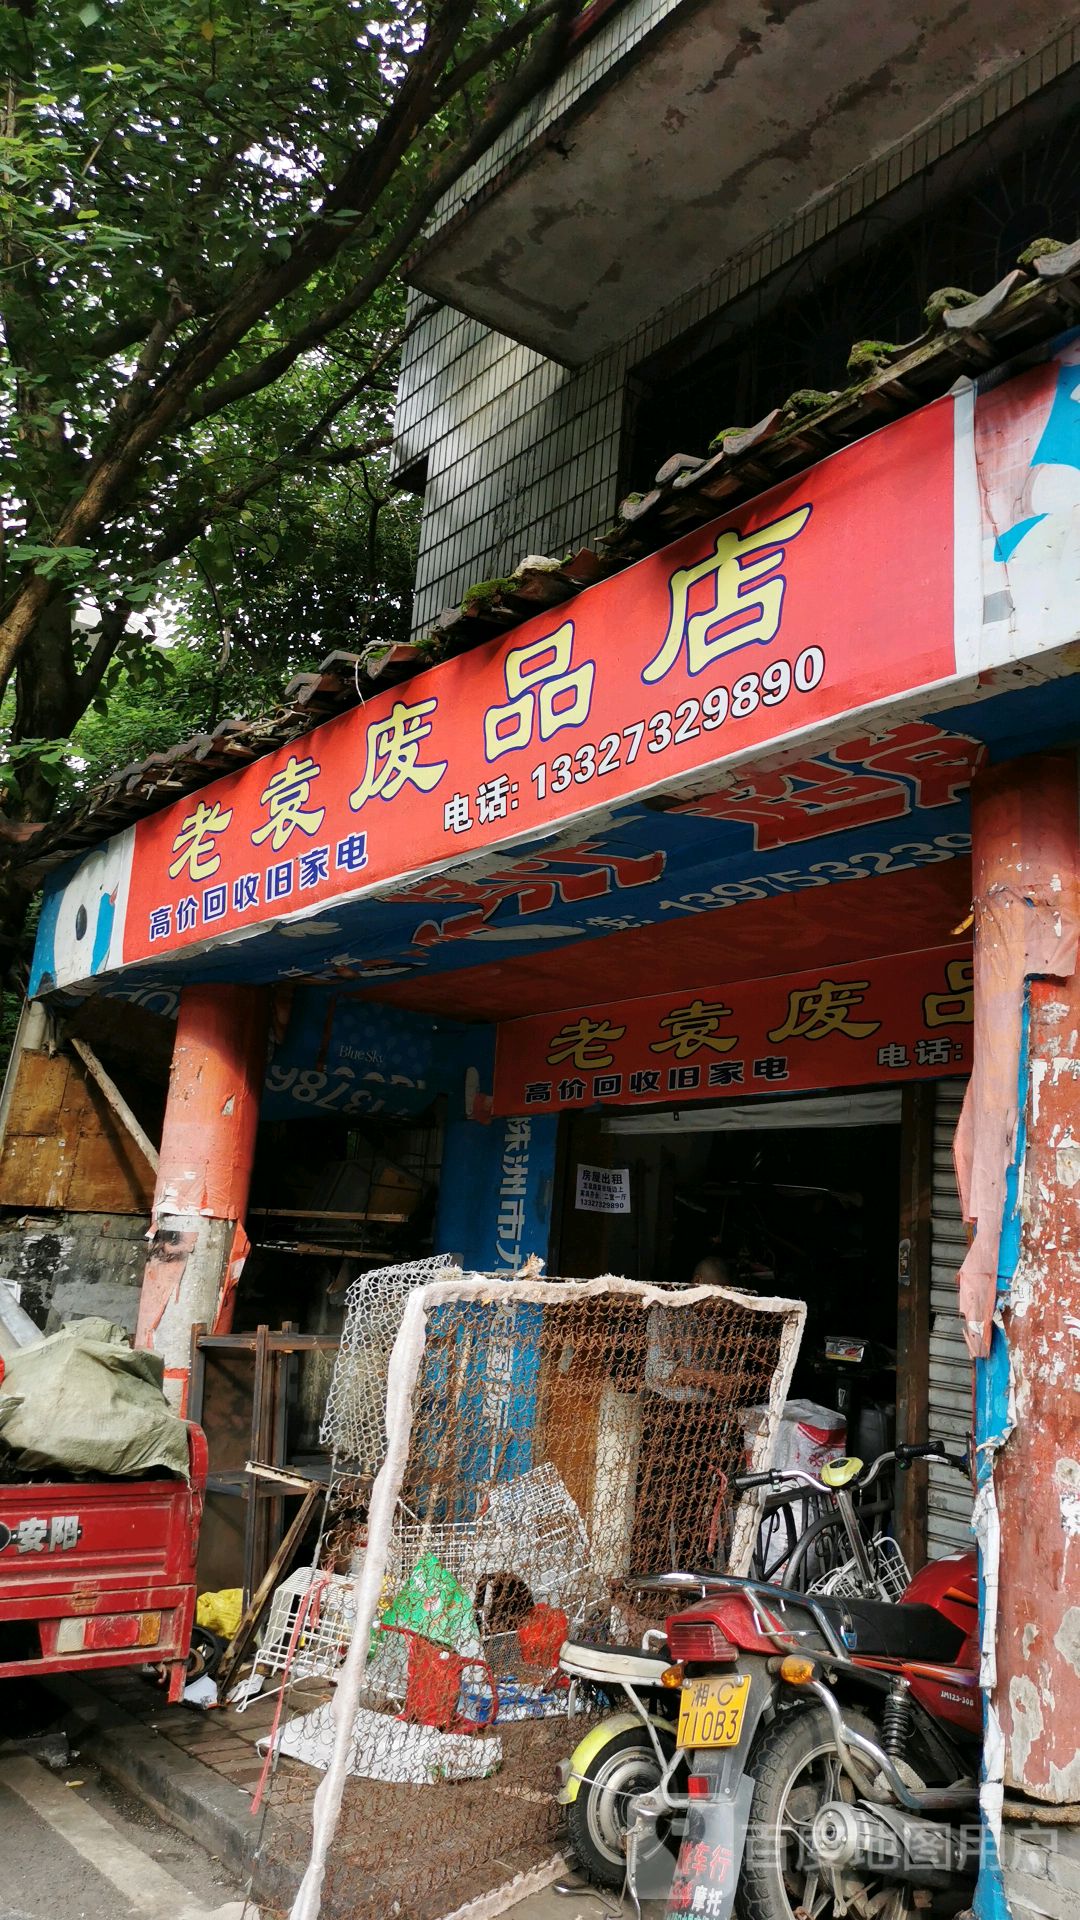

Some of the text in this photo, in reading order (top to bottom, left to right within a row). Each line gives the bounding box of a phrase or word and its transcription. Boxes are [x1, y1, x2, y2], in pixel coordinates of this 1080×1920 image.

[168, 503, 812, 881] 老袁废品店
[149, 831, 368, 941] 高价回收旧家电
[525, 1056, 789, 1104] 高价回收旧家电
[582, 1169, 622, 1185] 房屋出租
[17, 1515, 80, 1554] 安阳
[681, 1709, 739, 1743] 710B3
